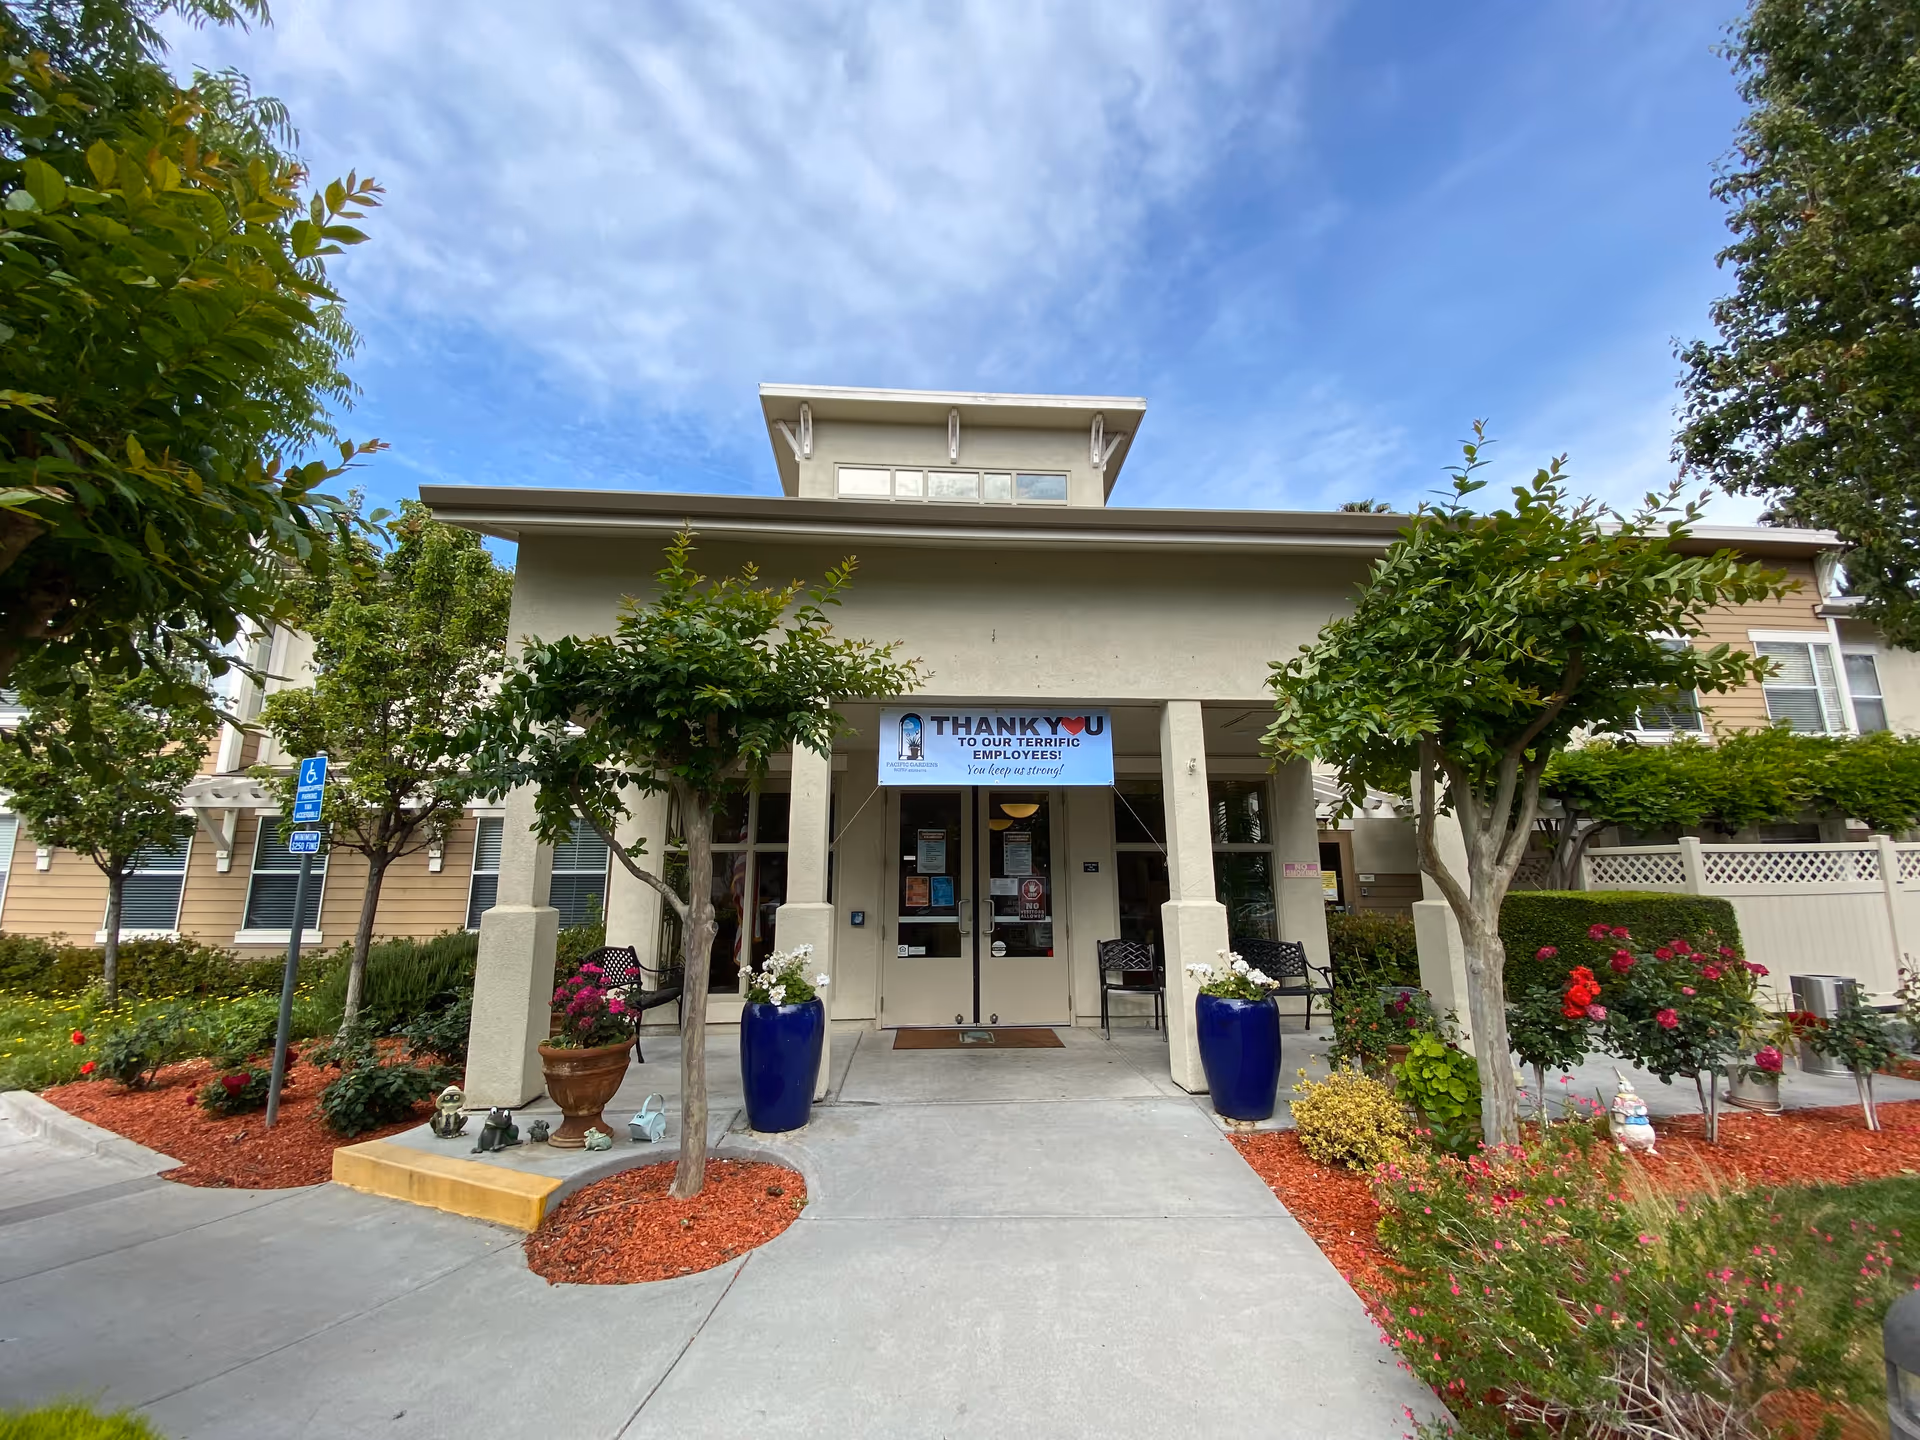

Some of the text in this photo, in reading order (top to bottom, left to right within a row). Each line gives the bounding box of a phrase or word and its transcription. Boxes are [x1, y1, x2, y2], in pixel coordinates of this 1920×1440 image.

[930, 716, 1040, 736] THANK
[958, 737, 1081, 747] TO OUR TERRIFIC
[973, 750, 1062, 760] EMPLOYEES!
[967, 763, 1065, 778] You keep us strong!
[291, 841, 318, 850] $250 FINE
